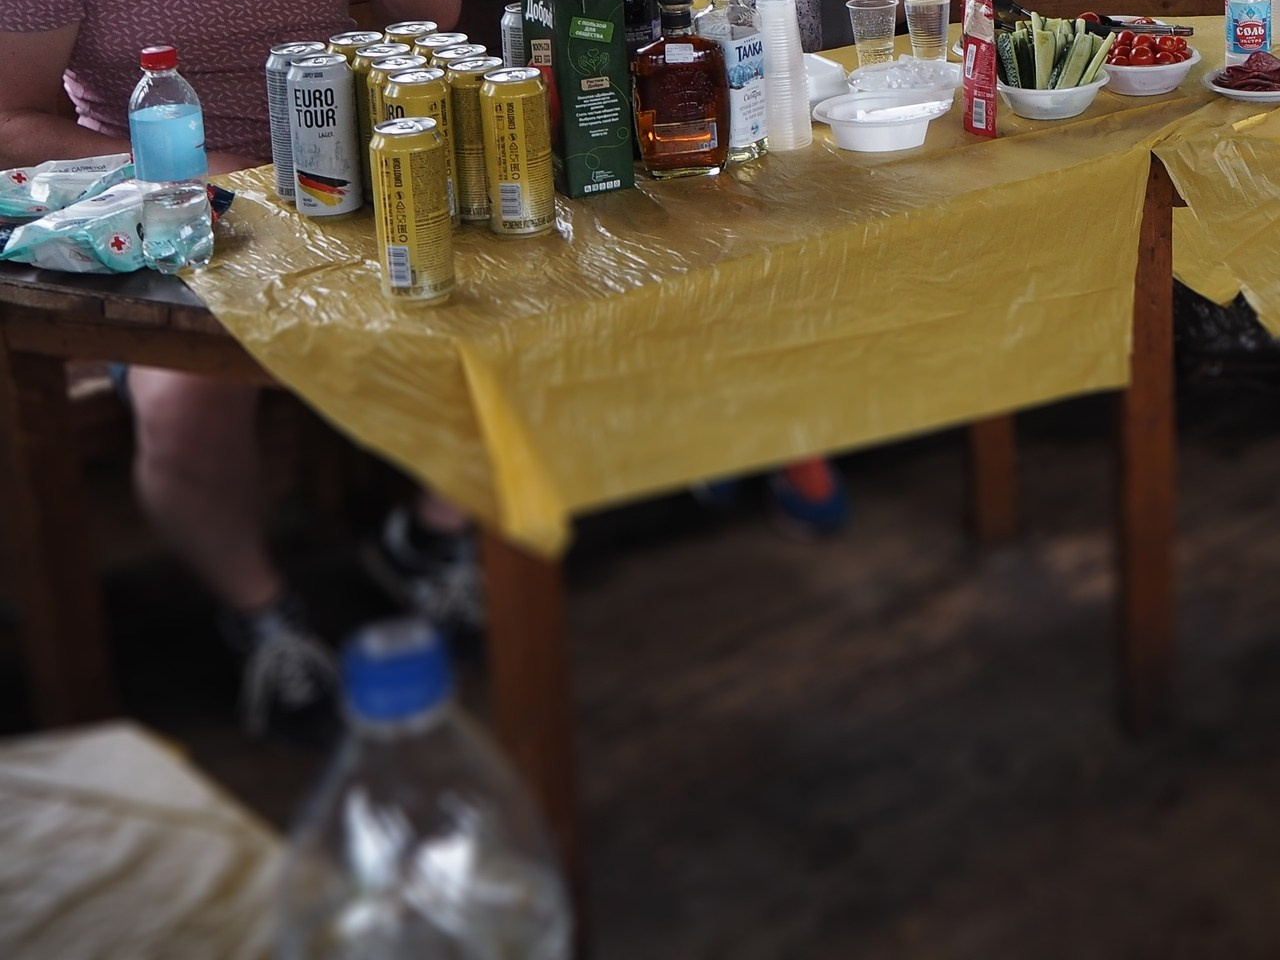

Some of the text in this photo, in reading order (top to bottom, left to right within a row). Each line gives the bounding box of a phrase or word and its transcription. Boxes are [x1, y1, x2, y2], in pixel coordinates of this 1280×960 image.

[1236, 26, 1265, 36] СОЛЬ
[735, 40, 763, 62] ТАЛКА
[294, 87, 335, 108] EURO
[295, 108, 336, 128] TOUR
